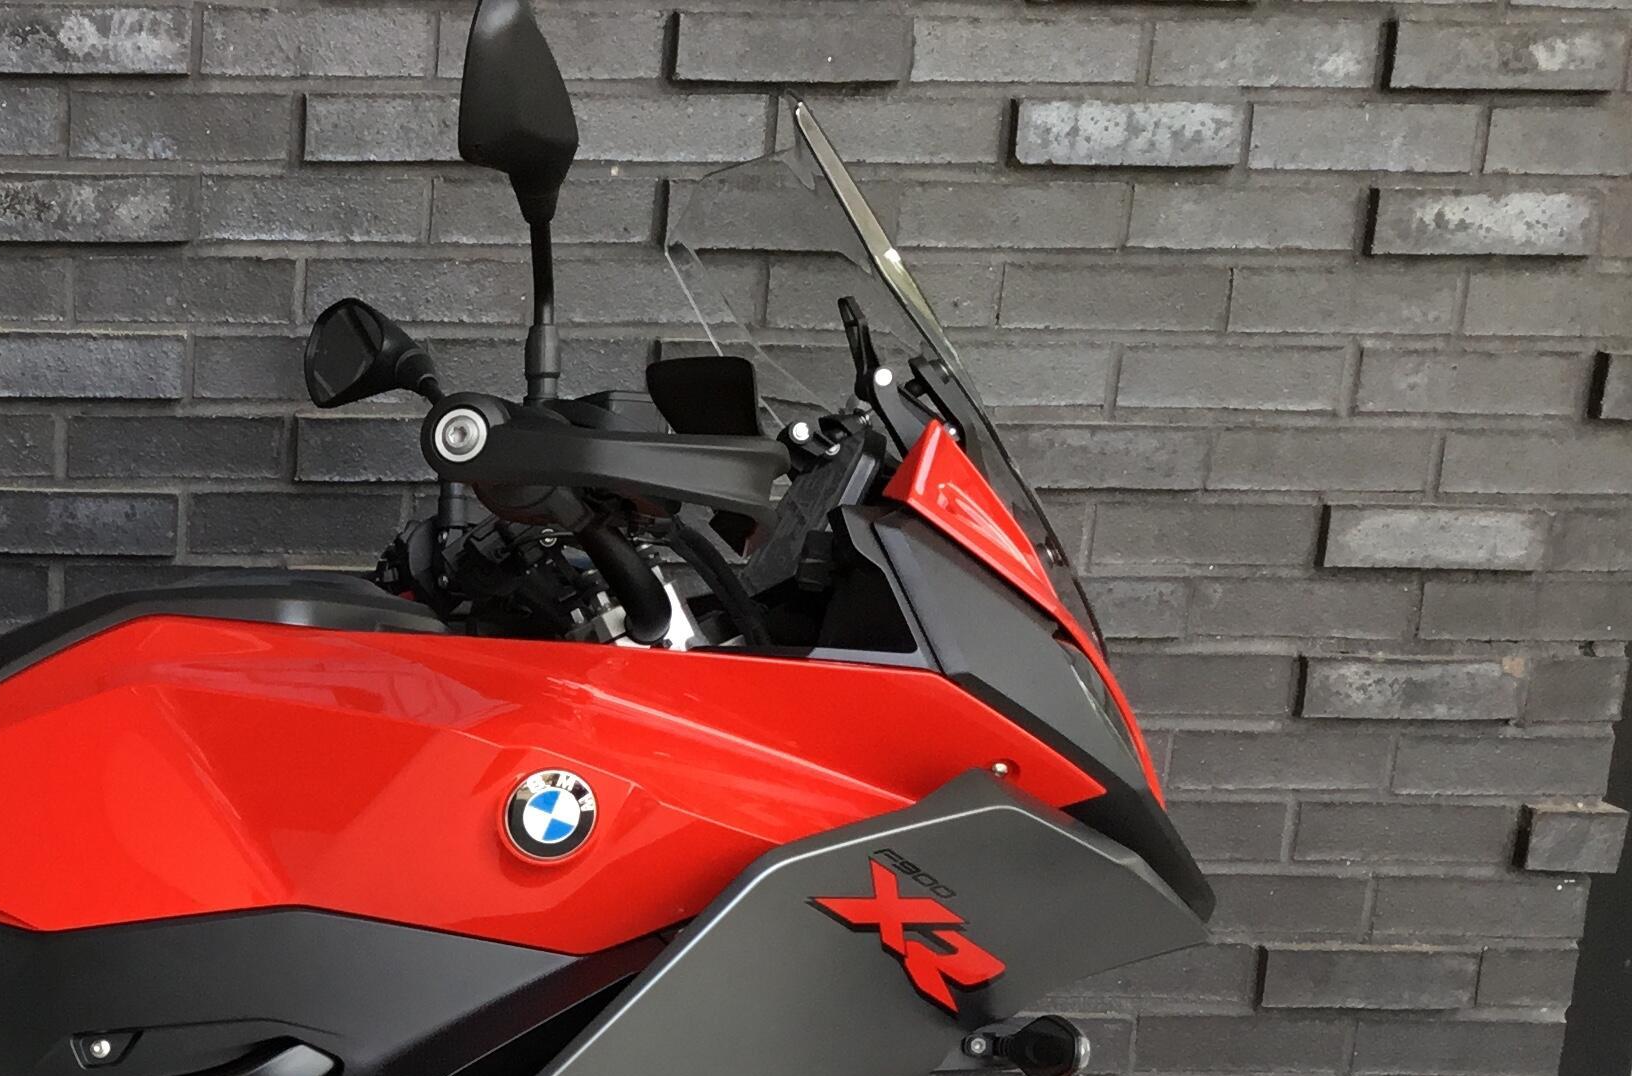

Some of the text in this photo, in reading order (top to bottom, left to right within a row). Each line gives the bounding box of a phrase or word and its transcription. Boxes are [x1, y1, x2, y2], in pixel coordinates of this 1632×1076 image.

[526, 773, 595, 812] BMW
[874, 848, 957, 899] F900
[806, 857, 1008, 1017] XR
